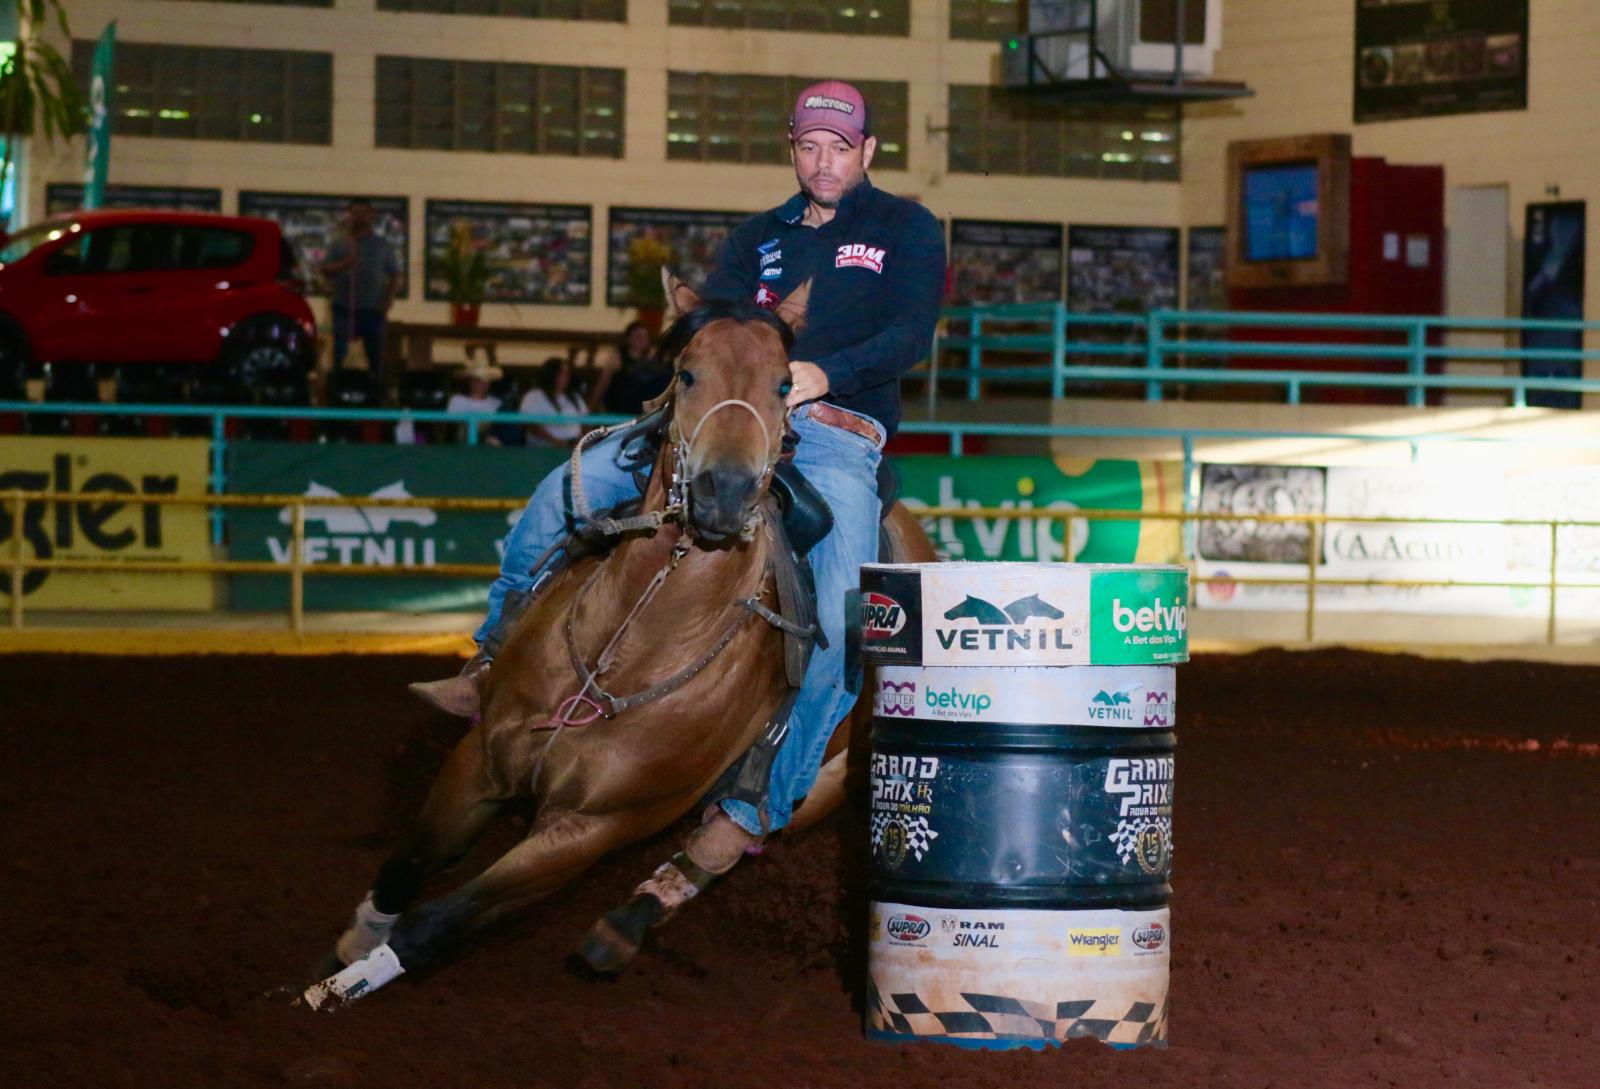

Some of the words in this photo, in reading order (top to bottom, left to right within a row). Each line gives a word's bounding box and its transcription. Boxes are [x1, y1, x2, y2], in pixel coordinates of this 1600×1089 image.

[838, 243, 886, 265] 3DM
[898, 475, 1090, 563] etvip
[266, 537, 436, 566] VETNIL
[1112, 597, 1187, 640] betvip
[935, 628, 1073, 651] VETNIL
[1124, 635, 1131, 645] A
[1132, 635, 1148, 645] Bet
[881, 692, 915, 705] CUTTER
[925, 685, 992, 716] betvip
[1088, 707, 1133, 720] VETNIL
[871, 752, 939, 779] RAND
[898, 801, 931, 814] MILHÃO
[1119, 783, 1168, 817] PRIX
[889, 921, 925, 935] SUPRA
[960, 921, 1005, 930] RAM
[953, 933, 1000, 948] SINAL
[1070, 933, 1120, 951] Wrangler
[1136, 929, 1163, 943] SUPRA
